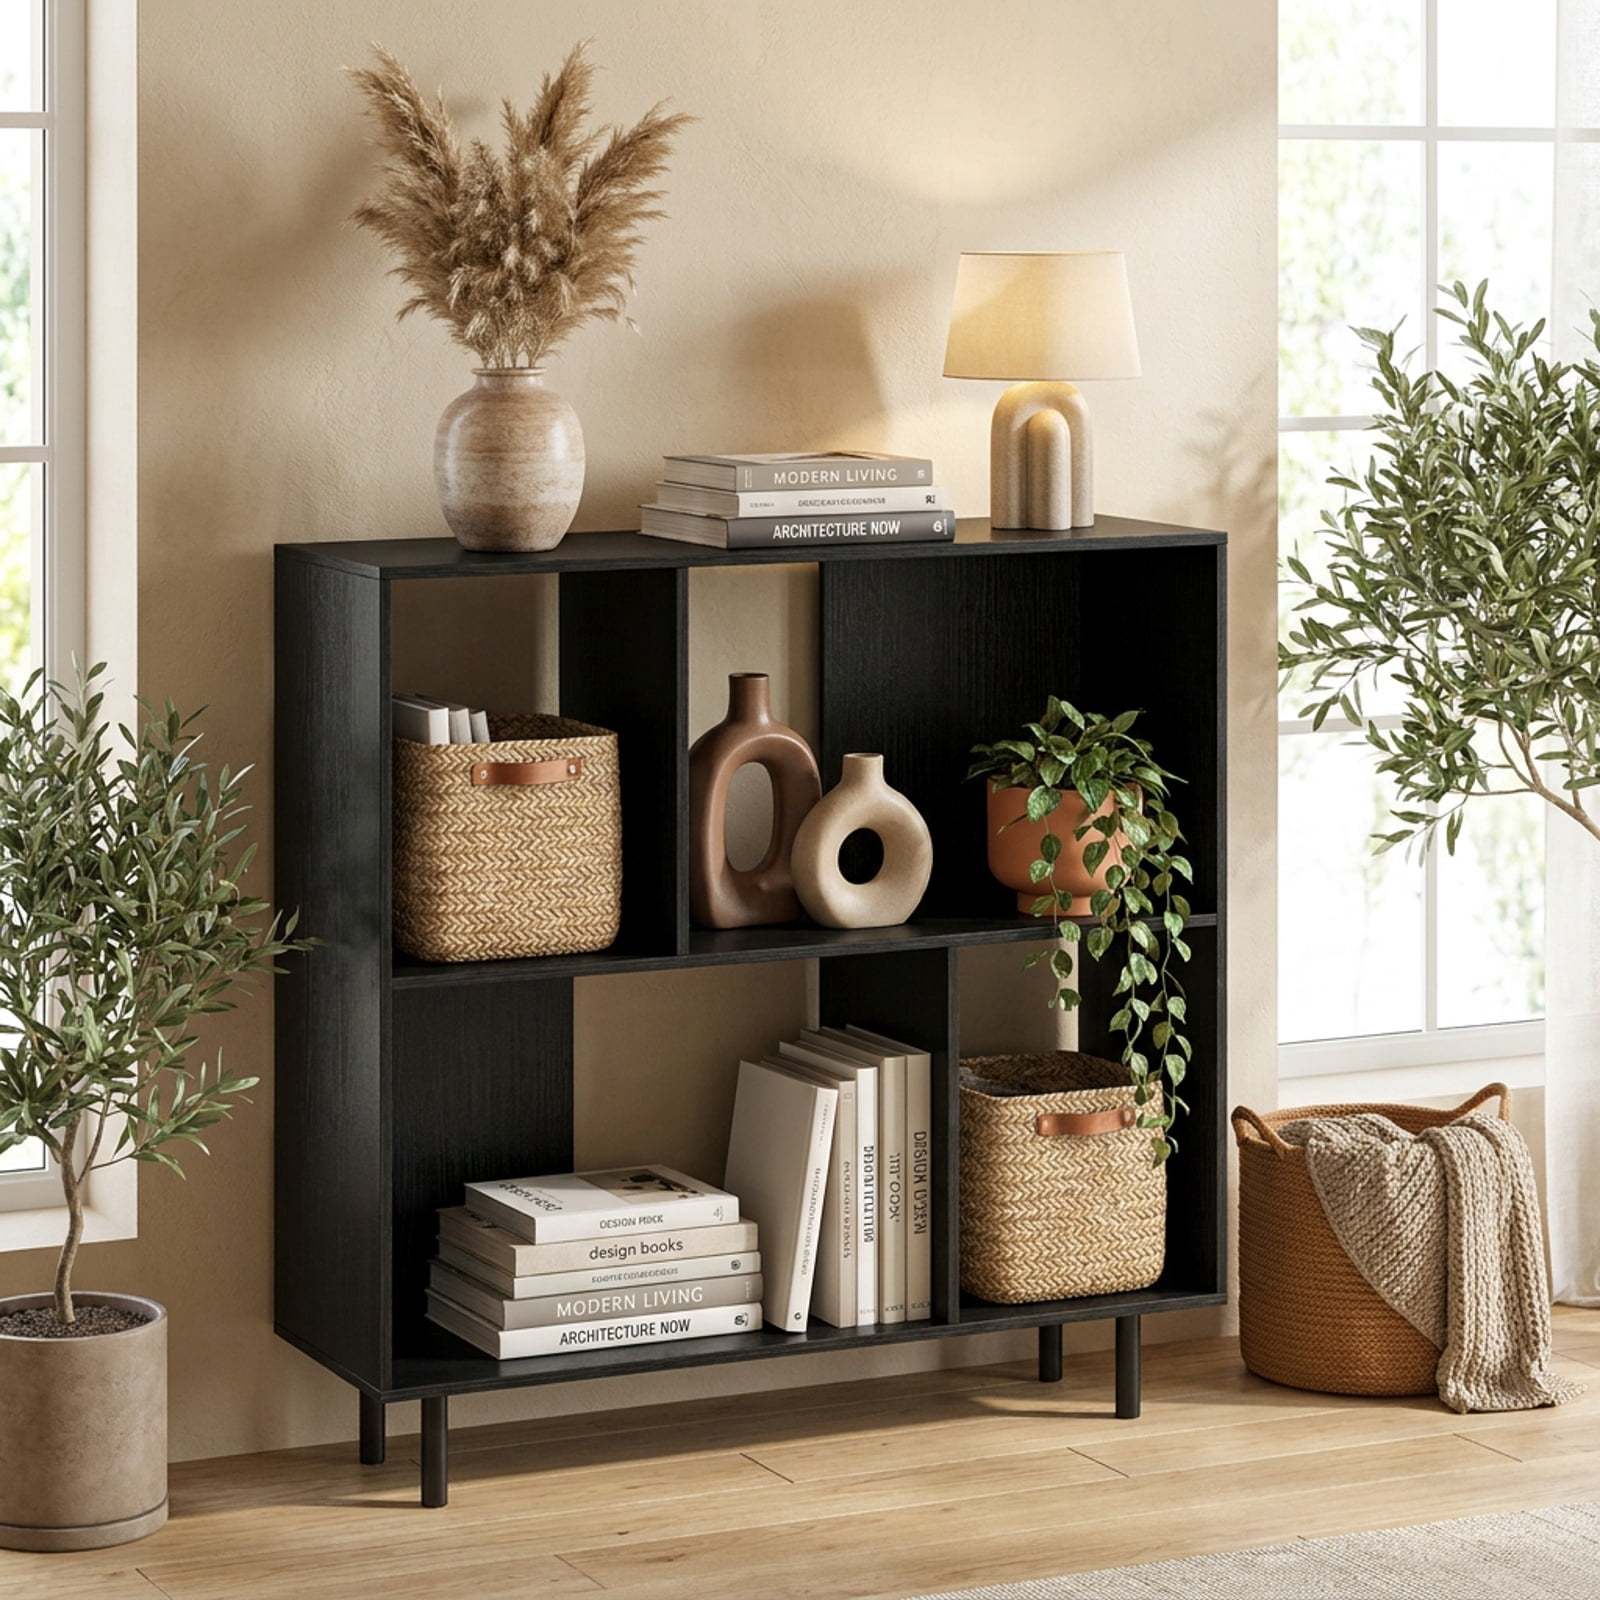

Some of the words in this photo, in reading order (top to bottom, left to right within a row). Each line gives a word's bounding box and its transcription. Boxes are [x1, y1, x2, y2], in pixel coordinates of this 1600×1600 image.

[774, 470, 840, 485] MODERN
[846, 468, 898, 482] LIVING
[773, 521, 867, 540] ARCHITECTURE
[871, 520, 901, 536] NOW
[588, 1242, 637, 1260] design
[640, 1238, 684, 1255] books
[556, 1293, 635, 1318] MODERN
[643, 1286, 703, 1307] LIVING
[559, 1321, 656, 1346] ARCHITECTURE
[660, 1318, 691, 1334] NOW
